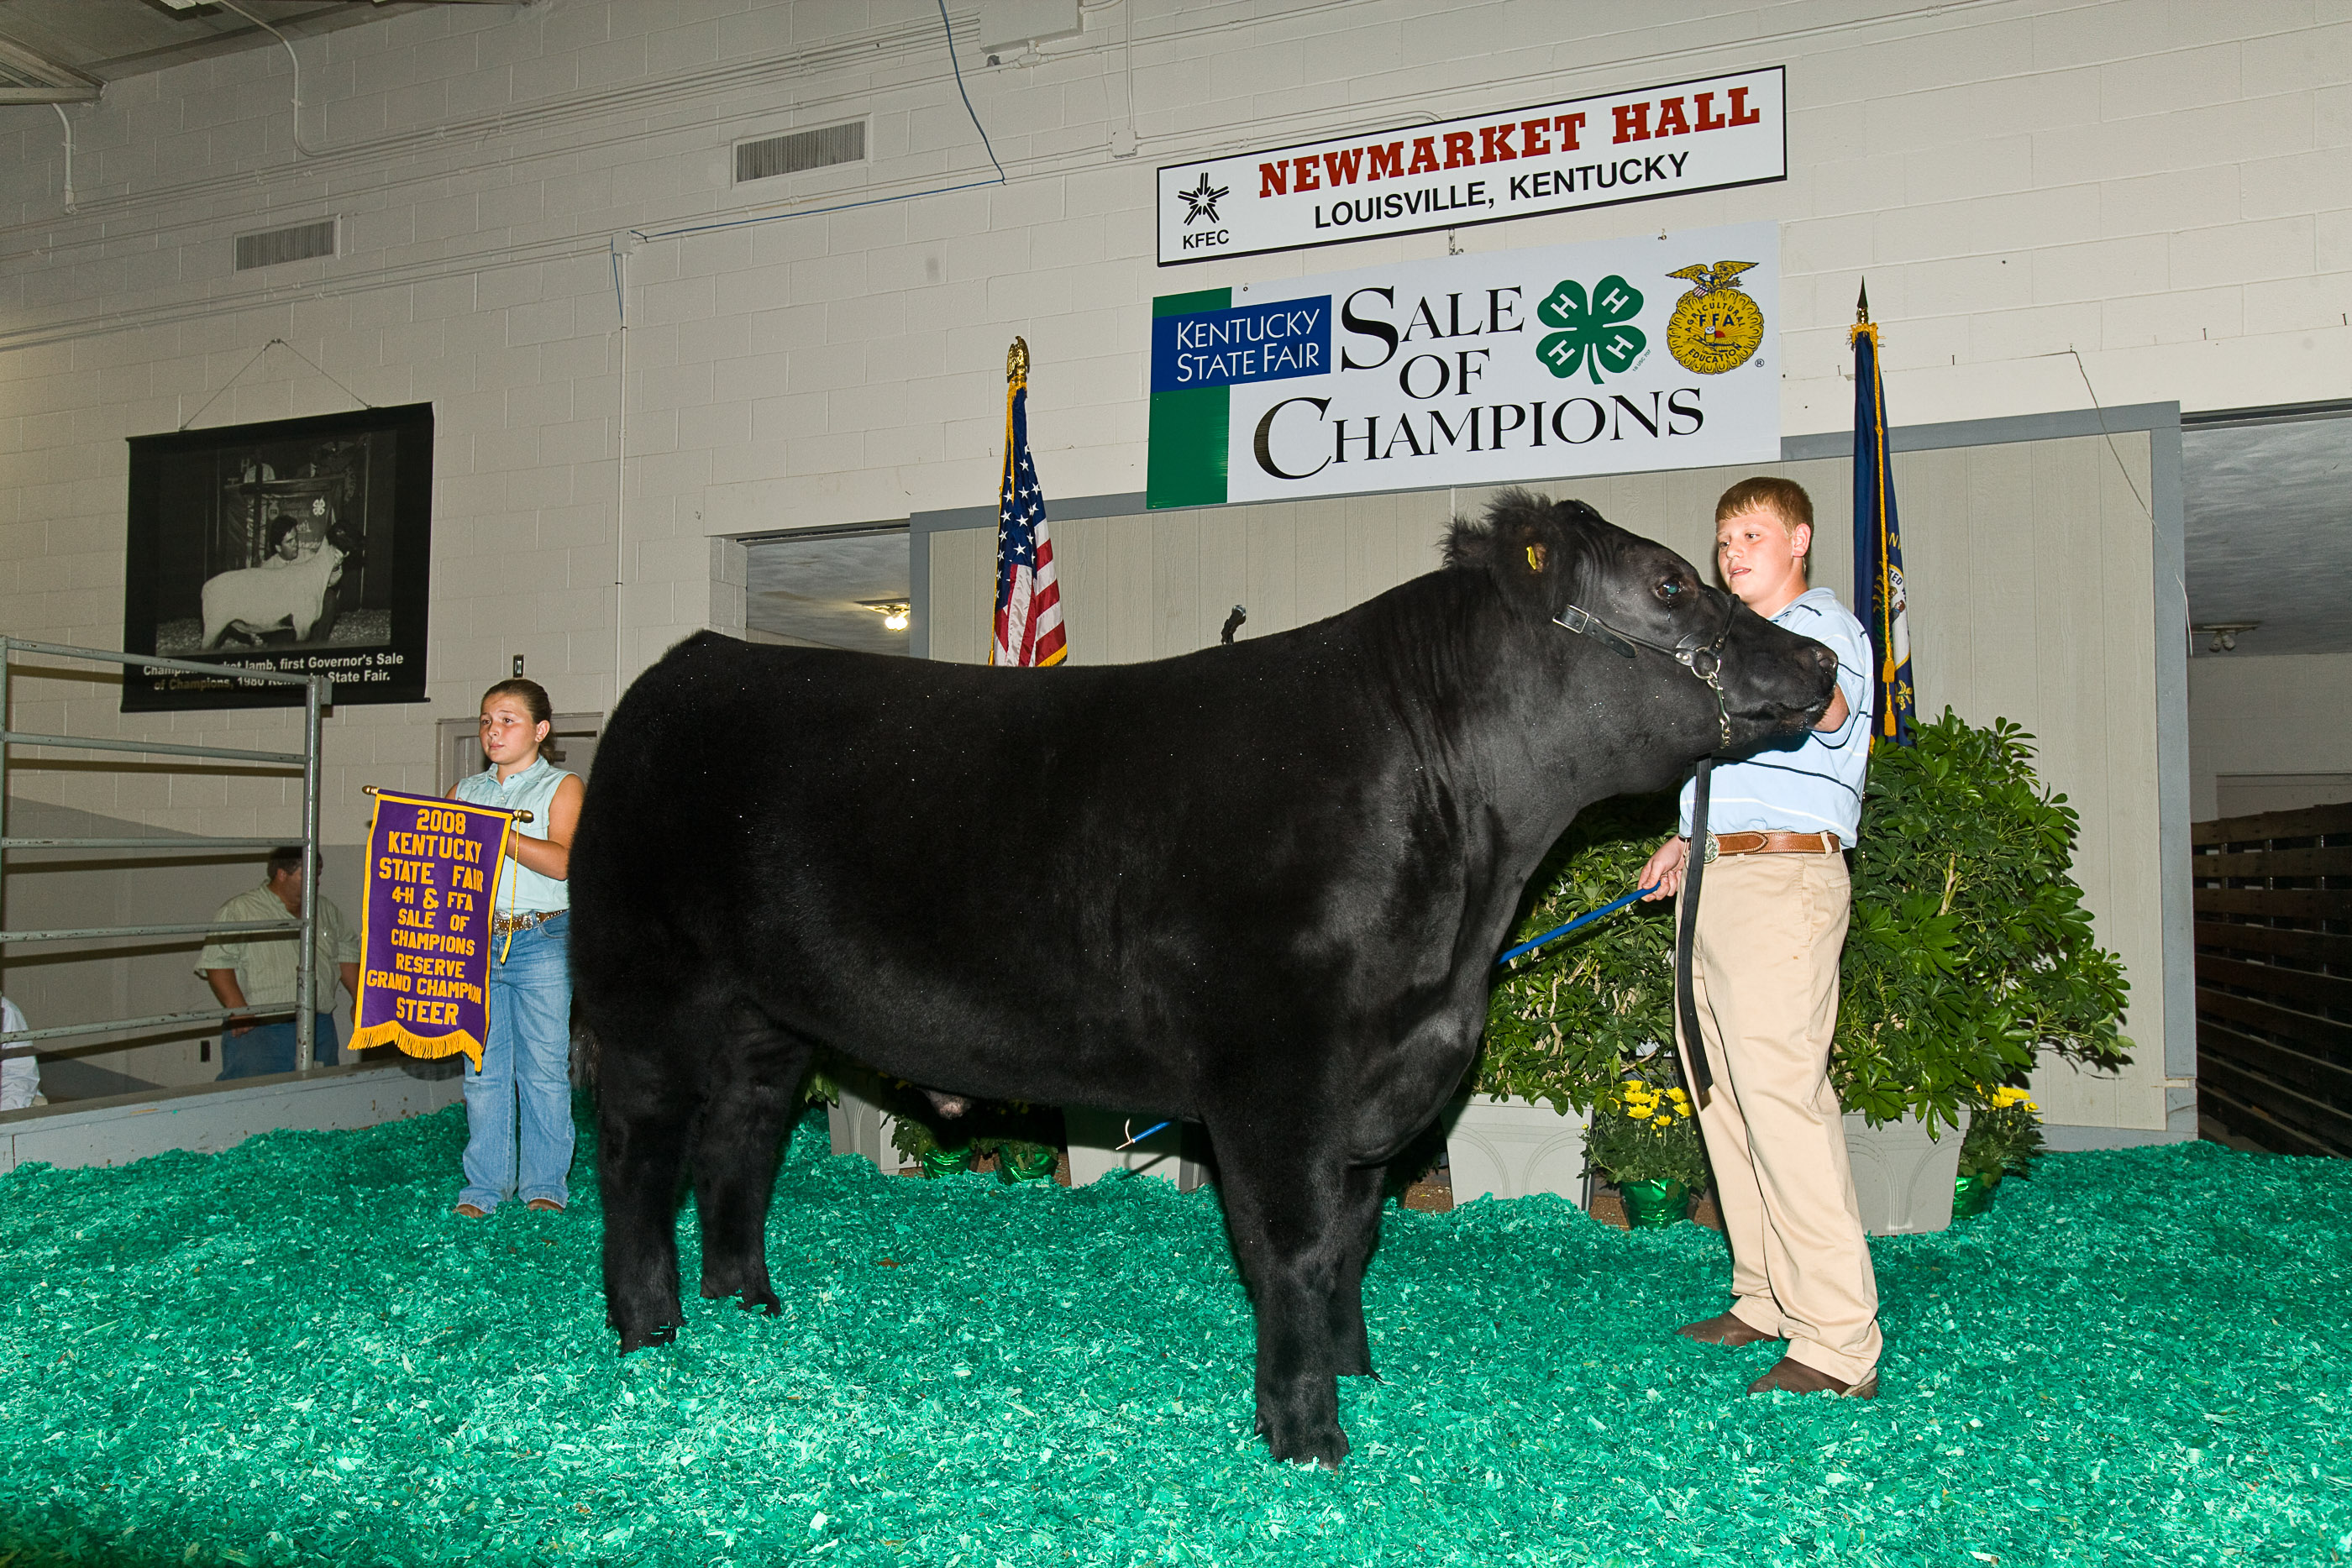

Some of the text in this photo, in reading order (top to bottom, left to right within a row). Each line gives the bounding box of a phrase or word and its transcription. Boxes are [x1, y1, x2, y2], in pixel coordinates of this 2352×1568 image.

[1258, 87, 1760, 198] NEWMARKET HALL
[1315, 150, 1689, 229] LOUISVILLE, KENTUCKY
[1183, 229, 1230, 250] KFEC
[1177, 308, 1320, 350] KENTUCKY
[1341, 285, 1525, 373] SALE
[1684, 302, 1746, 333] AGRICULTURAL
[1698, 313, 1735, 328] FFA
[1177, 342, 1320, 382] STATE FAIR
[1688, 342, 1742, 364] EDUCATION
[1399, 348, 1490, 400] OF
[1253, 387, 1704, 480] CHAMPIONS
[280, 658, 304, 670] first
[307, 654, 372, 669] Governor's
[376, 653, 404, 665] Sale
[154, 679, 166, 691] of
[169, 677, 234, 692] Champions,
[328, 671, 360, 683] State
[364, 669, 391, 682] Fair.
[415, 808, 466, 835] 2008
[388, 831, 482, 863] KENTUCKY
[379, 857, 484, 893] STATE FAIR
[391, 886, 474, 912] 4-H & FFA
[397, 908, 470, 932] SALE OF
[391, 928, 475, 957] CHAMPIONS
[396, 952, 465, 979] RESERVE
[366, 969, 482, 1004] GRAND CHAMPION
[396, 996, 459, 1025] STEER
